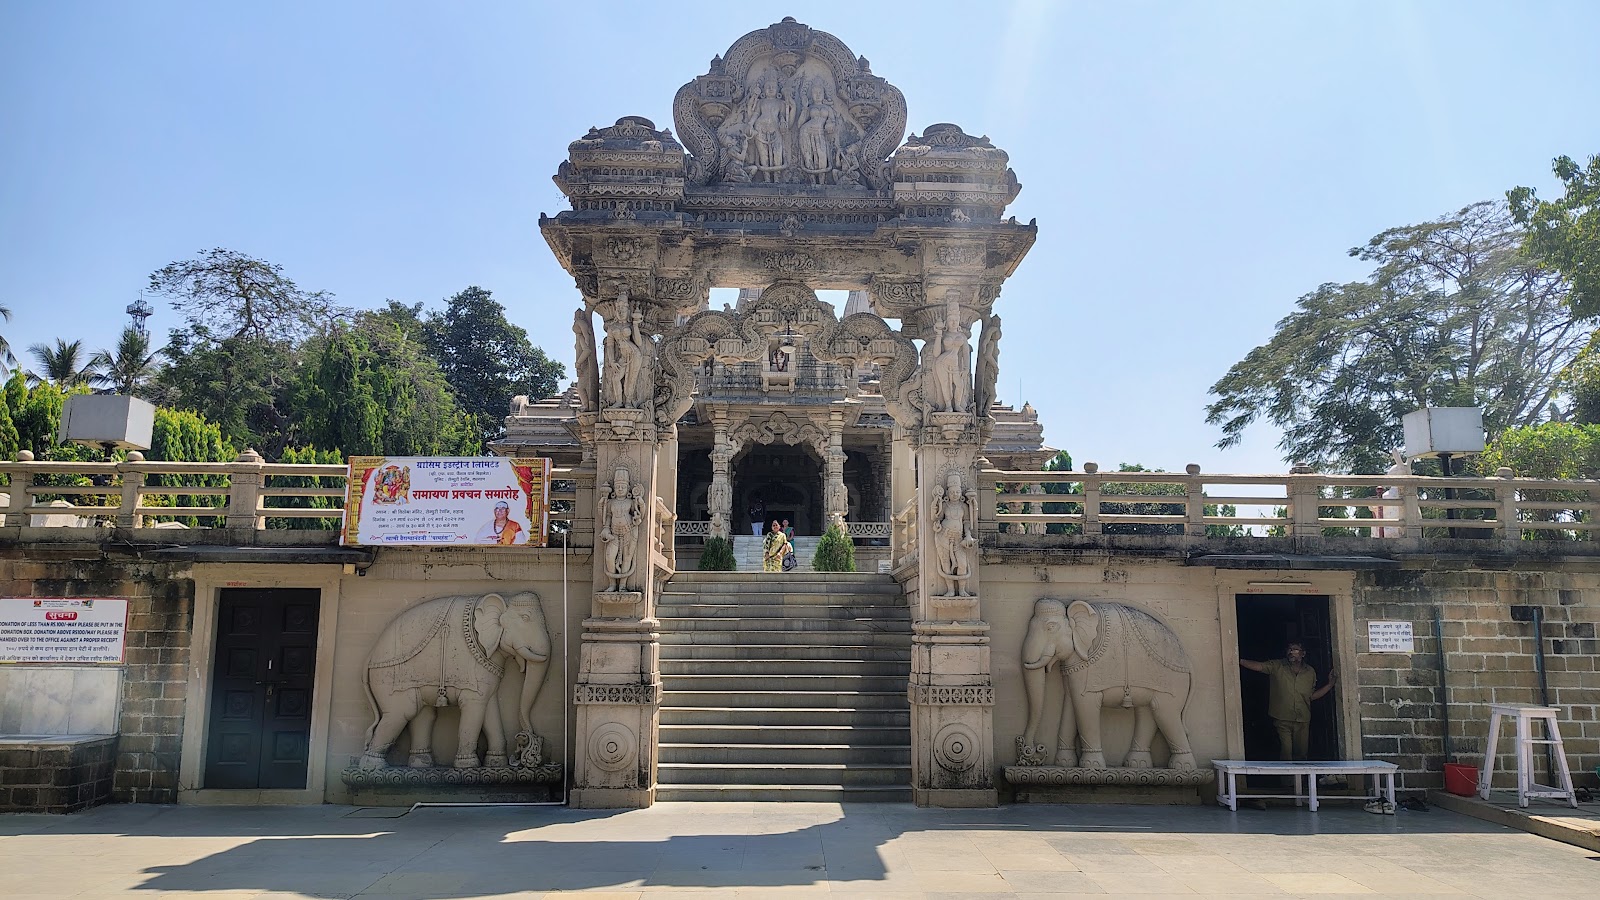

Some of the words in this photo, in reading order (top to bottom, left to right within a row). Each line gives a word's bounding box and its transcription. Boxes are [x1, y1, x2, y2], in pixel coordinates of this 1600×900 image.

[413, 490, 449, 499] रामायण
[452, 490, 482, 499] प्रवचन
[485, 486, 519, 500] समारोह
